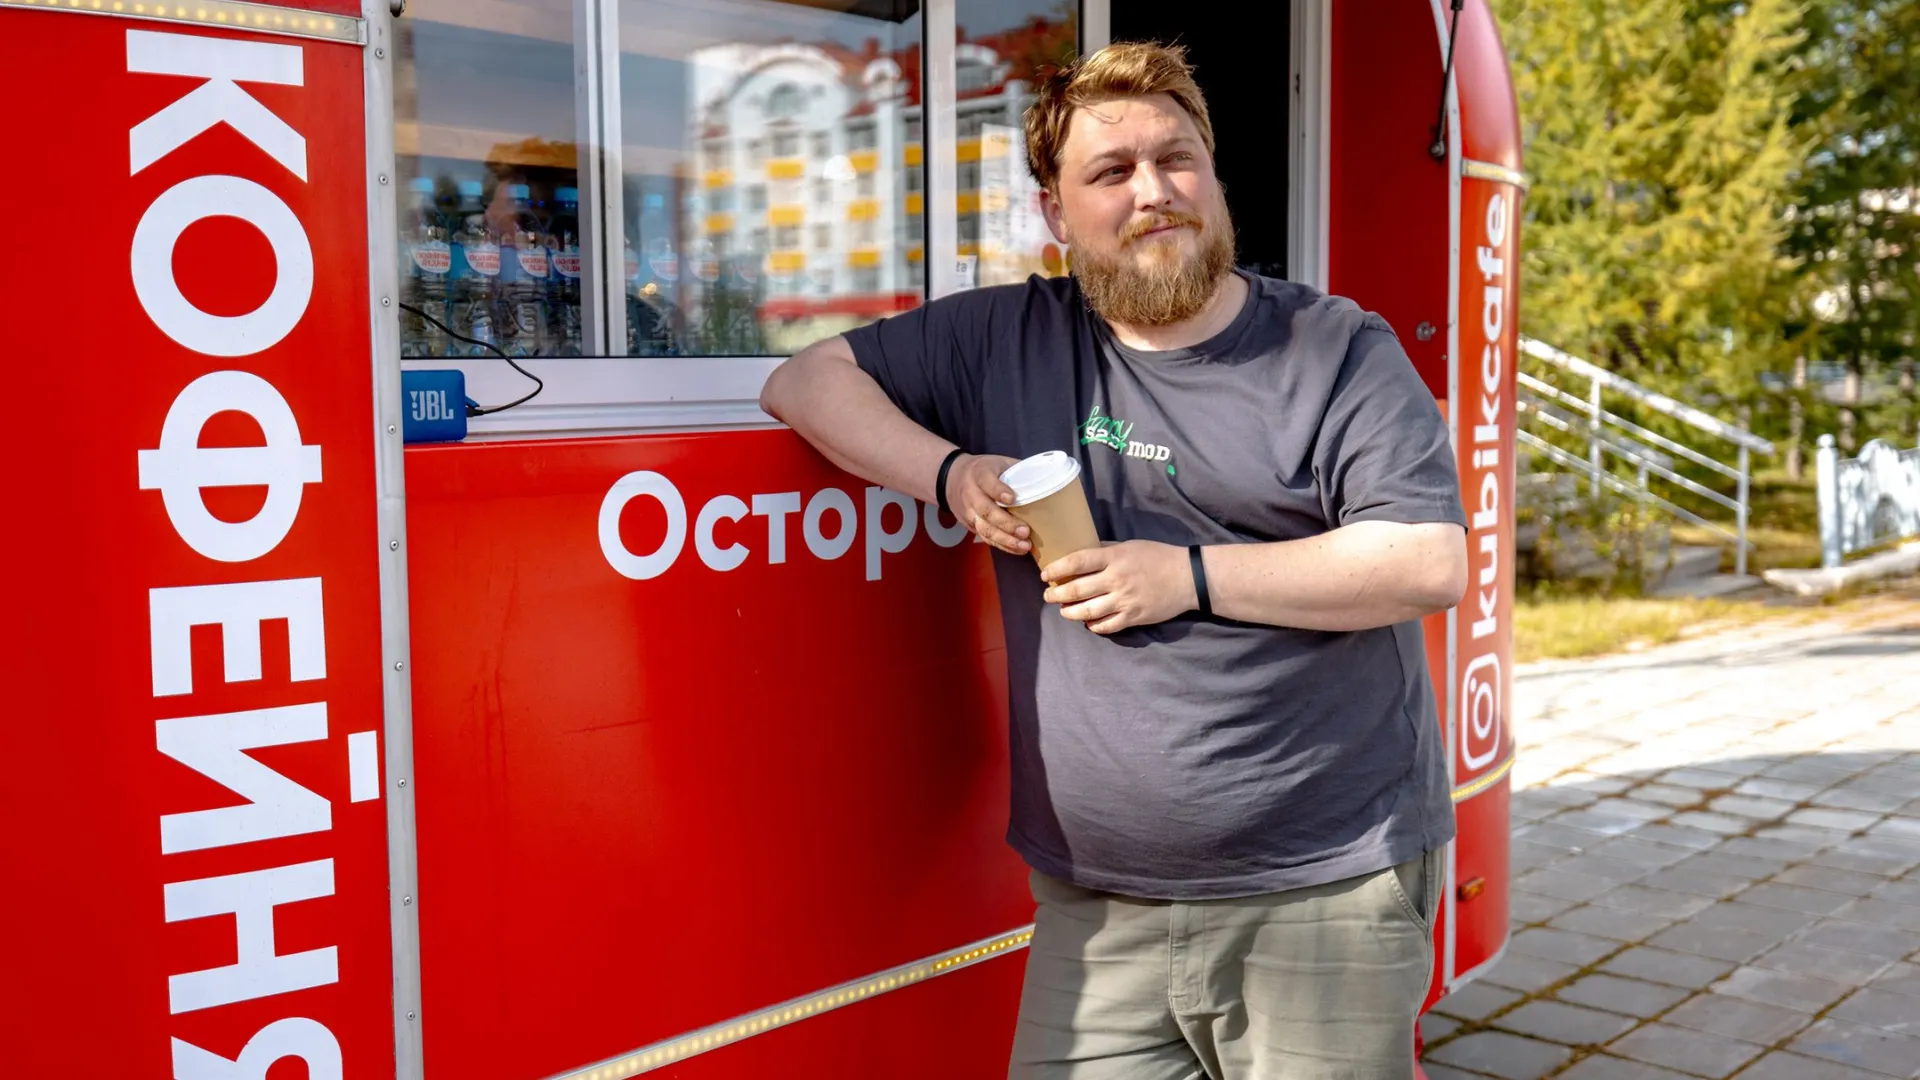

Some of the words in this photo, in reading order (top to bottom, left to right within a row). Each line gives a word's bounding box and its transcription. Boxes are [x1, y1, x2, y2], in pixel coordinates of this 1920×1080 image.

[409, 390, 454, 421] JBL
[1471, 192, 1507, 640] kubikcafe
[597, 469, 984, 582] Осторо
